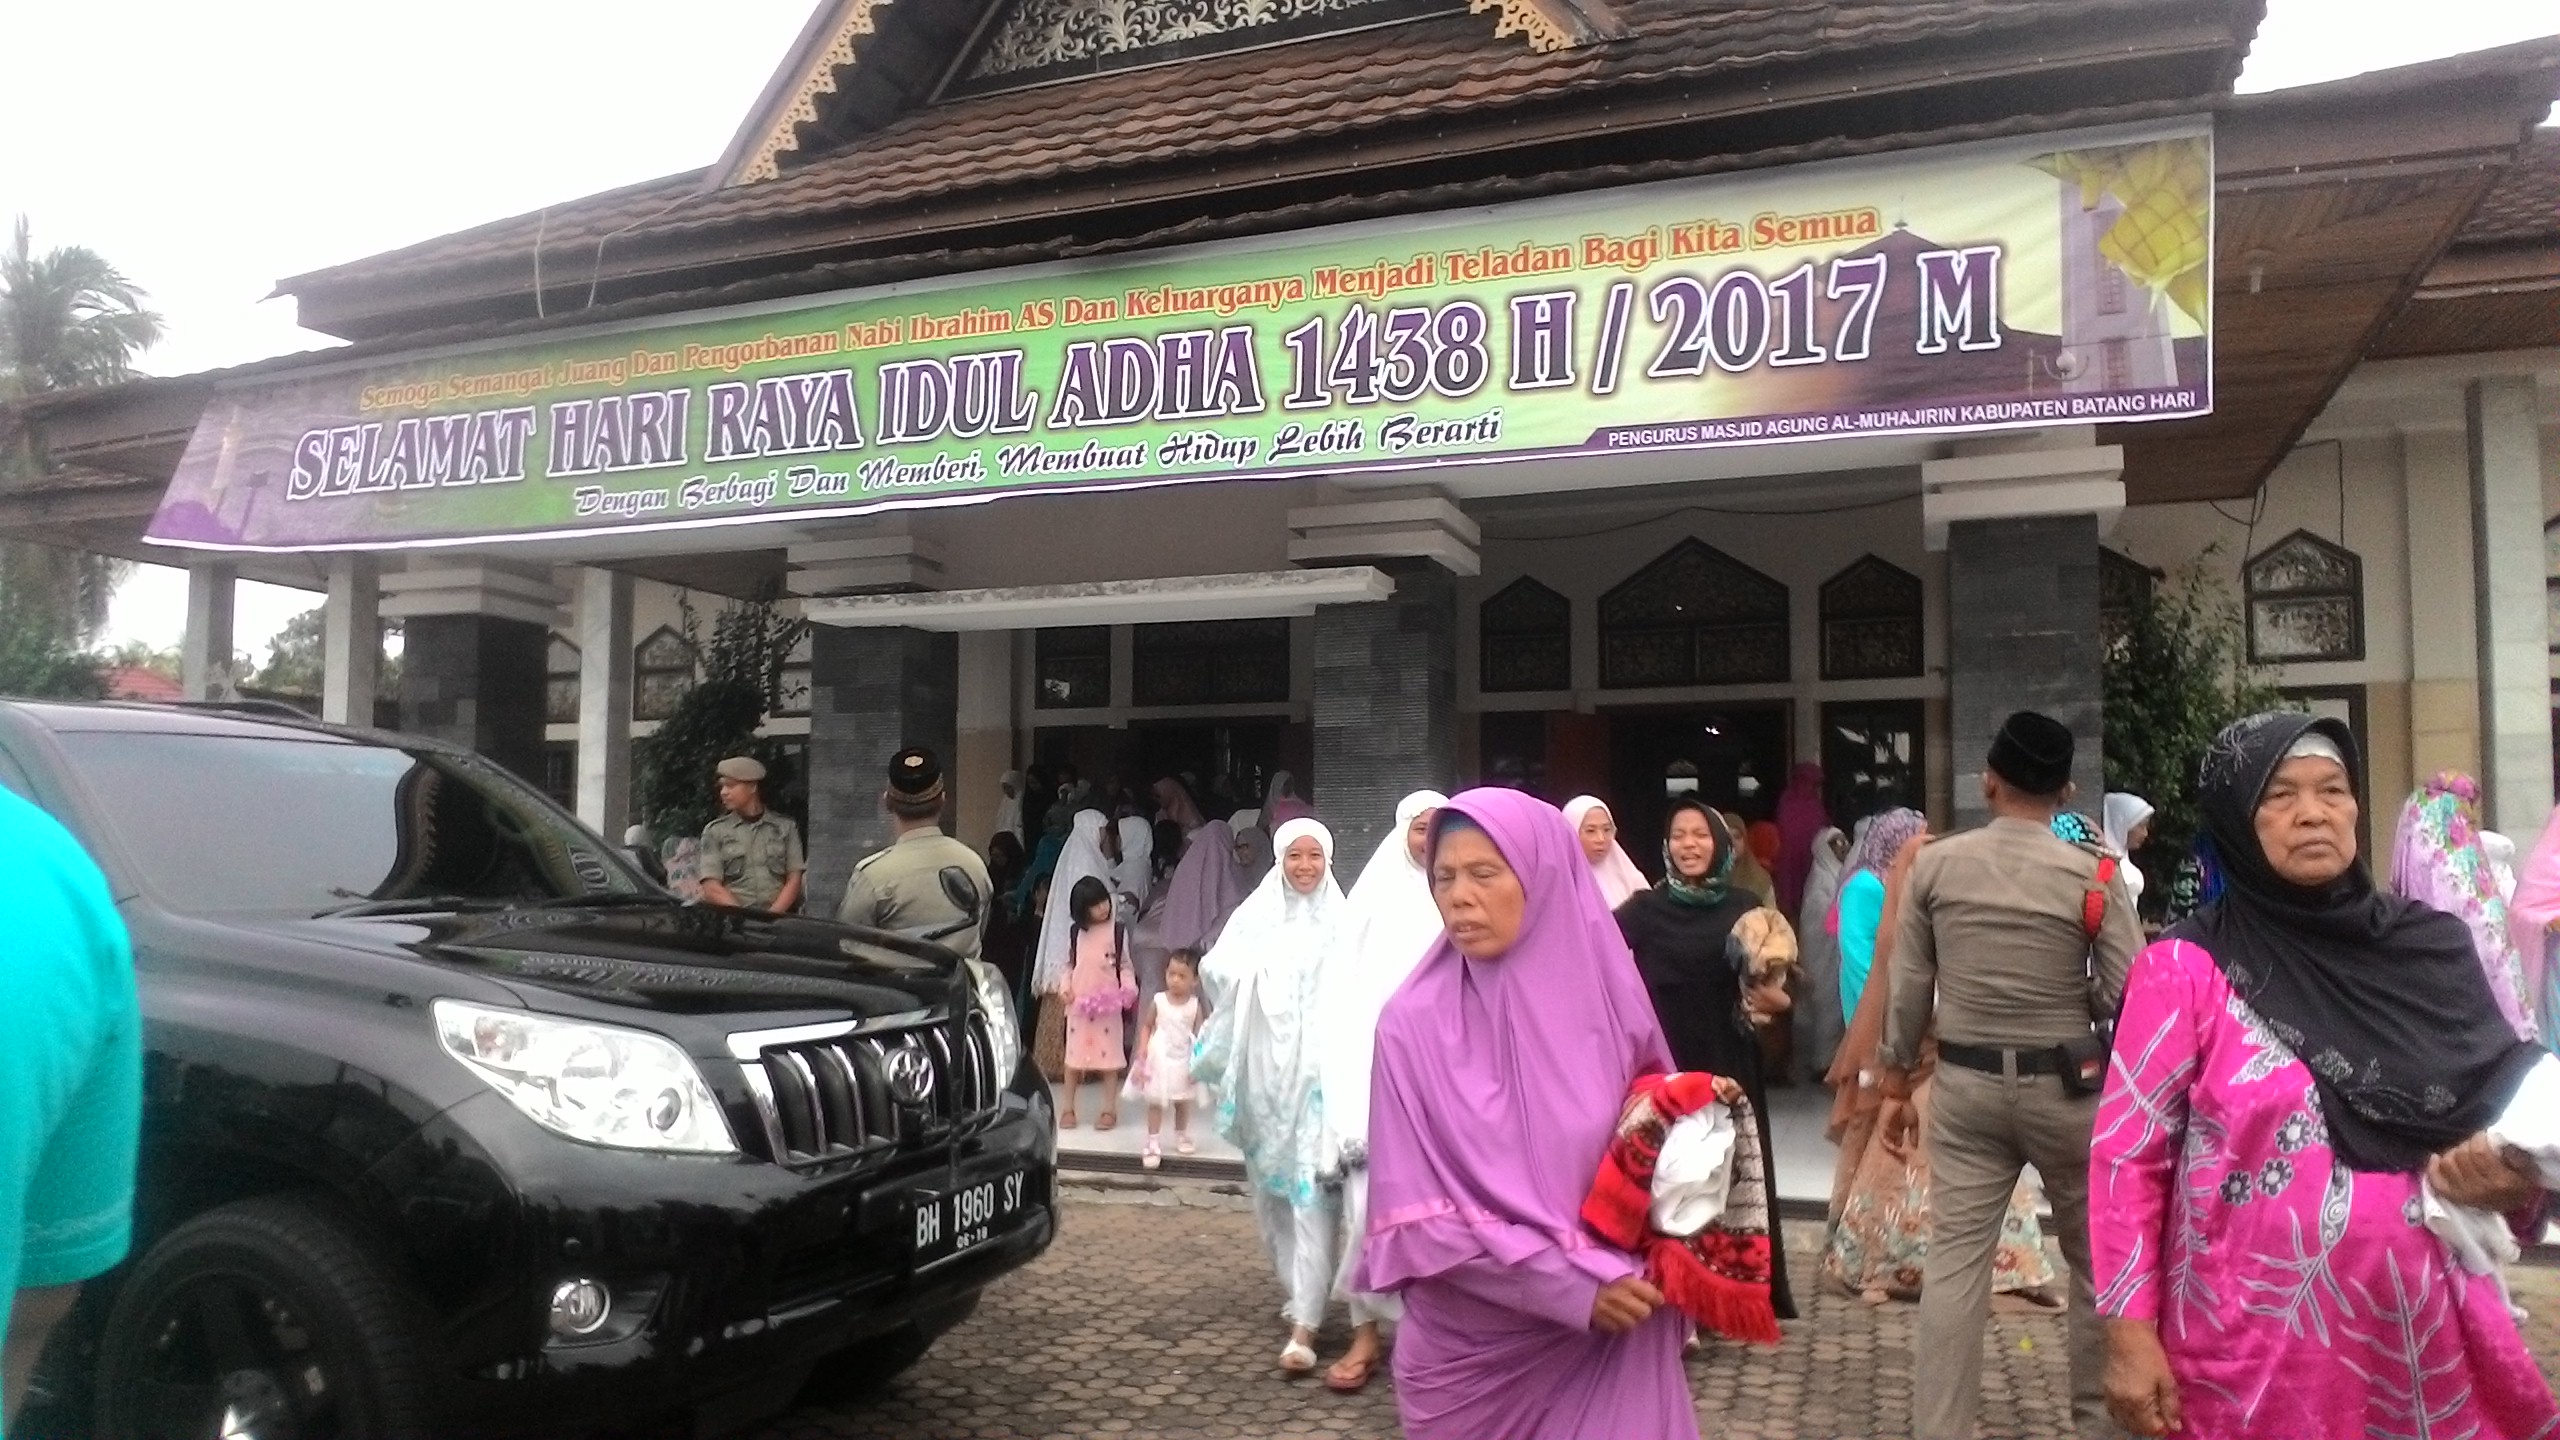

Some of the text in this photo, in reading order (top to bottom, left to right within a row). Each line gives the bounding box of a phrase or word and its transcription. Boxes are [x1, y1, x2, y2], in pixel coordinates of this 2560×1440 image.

[360, 207, 1879, 411] Semoga Semangat Juang Dan Pengorbanan Nabi Ibrahim AS Dan Keluarganya Menjadi Teladan Bagi Kita Semua
[288, 246, 2002, 502] SELAMAT HARI RAYA IDUL ADHA 1438 H / 2017 M
[1608, 391, 2196, 448] PENGURUS MASJID AGUNG AL-MUHAJIRIN KABUPATEN BATANG HARI
[574, 407, 1503, 517] Dengan Berbagi Dan Memberi, Membuat Hidup Lebih Berarti
[917, 1170, 1025, 1248] BH 1960 SY
